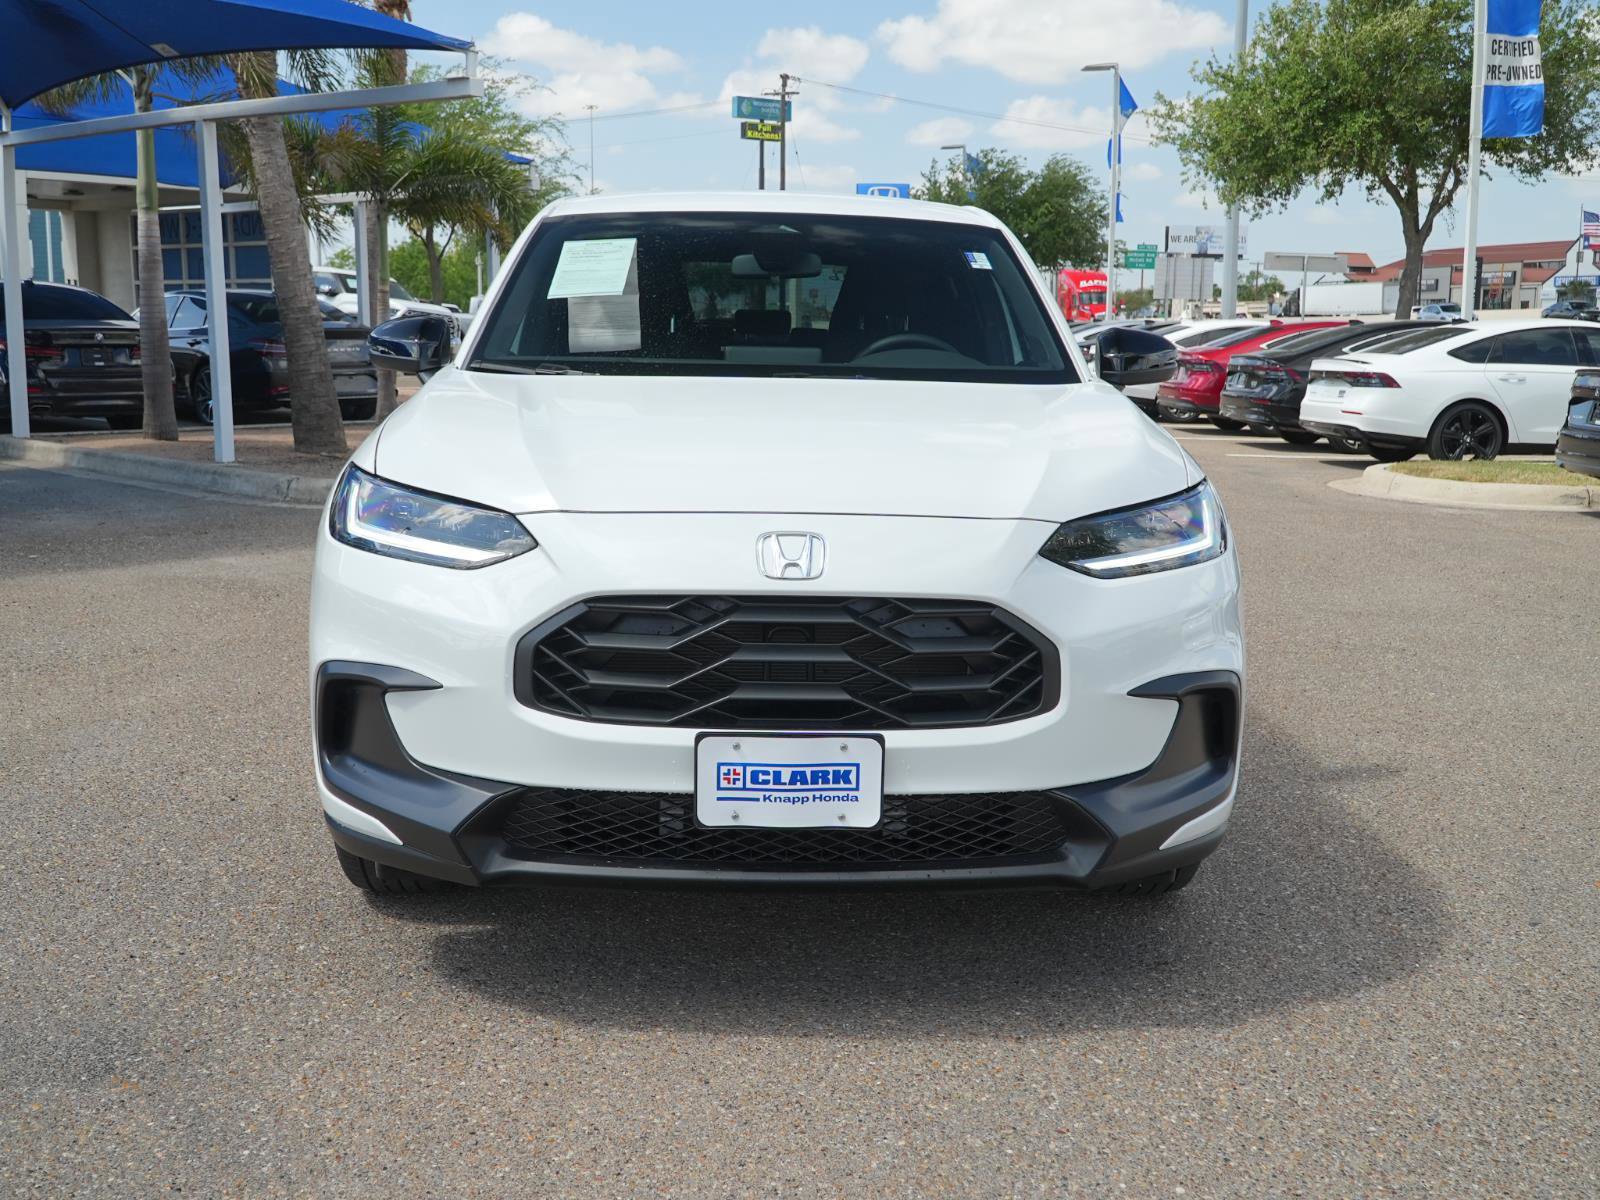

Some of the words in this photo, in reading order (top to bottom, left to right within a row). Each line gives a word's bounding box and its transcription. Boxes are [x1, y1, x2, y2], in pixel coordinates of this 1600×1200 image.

[1491, 39, 1534, 57] CERTIFIED
[1486, 64, 1541, 81] PRE-OWNED
[757, 123, 772, 131] Full
[1170, 235, 1182, 243] WE
[749, 769, 853, 786] CLARK
[762, 793, 810, 805] Knapp
[812, 793, 859, 803] Honda
